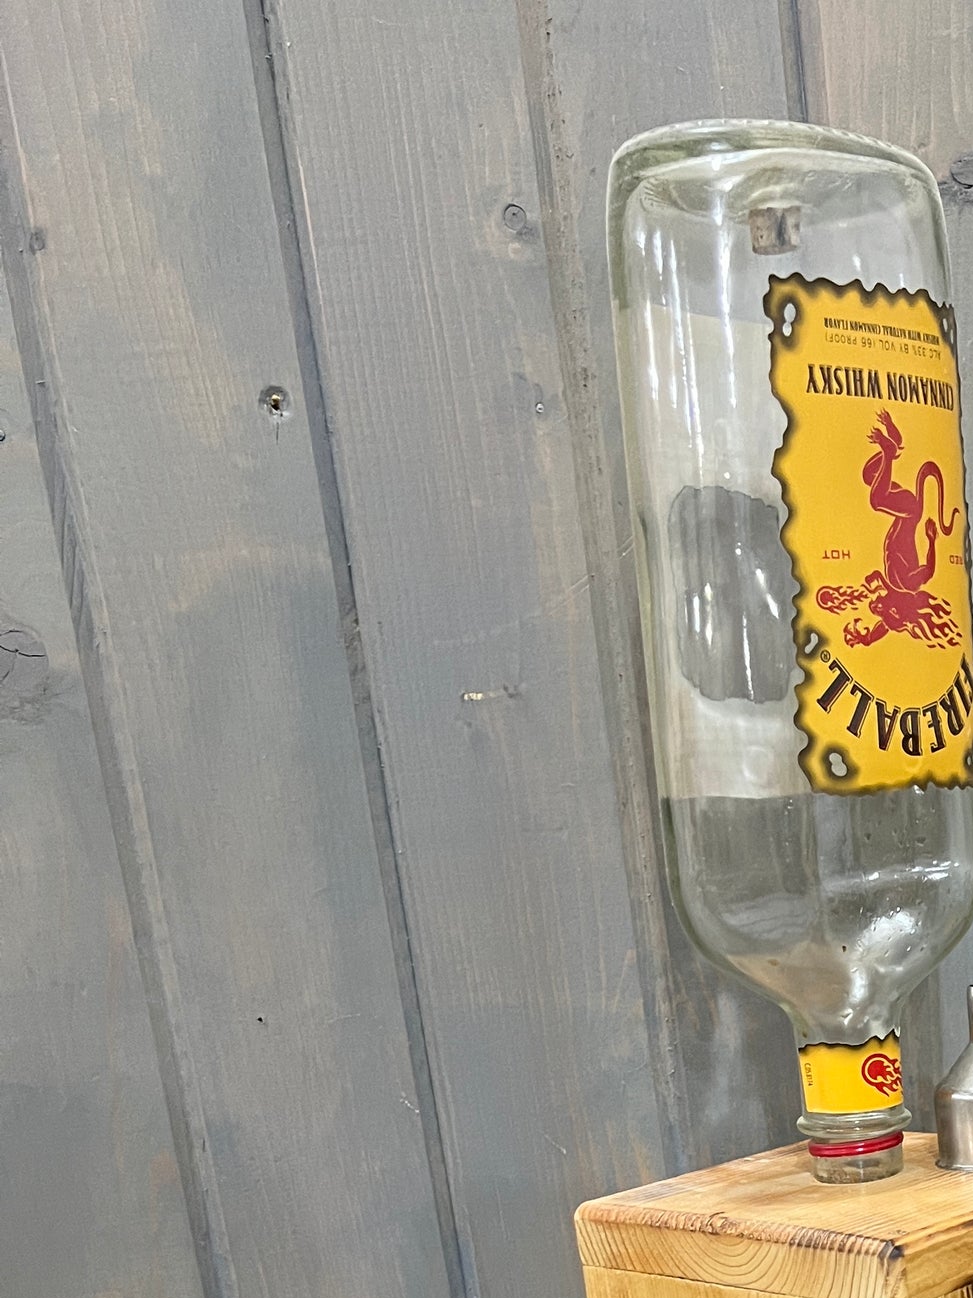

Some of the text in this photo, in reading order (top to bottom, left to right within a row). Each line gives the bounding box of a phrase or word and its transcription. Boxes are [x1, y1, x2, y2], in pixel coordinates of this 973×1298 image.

[824, 317, 849, 331] FLAVOR
[850, 320, 881, 335] CINNAMON
[882, 325, 907, 339] NATURAL
[879, 340, 895, 351] VOL
[899, 343, 909, 354] BY
[806, 364, 954, 411] CINNAMON WHISKY
[822, 550, 850, 559] HOT
